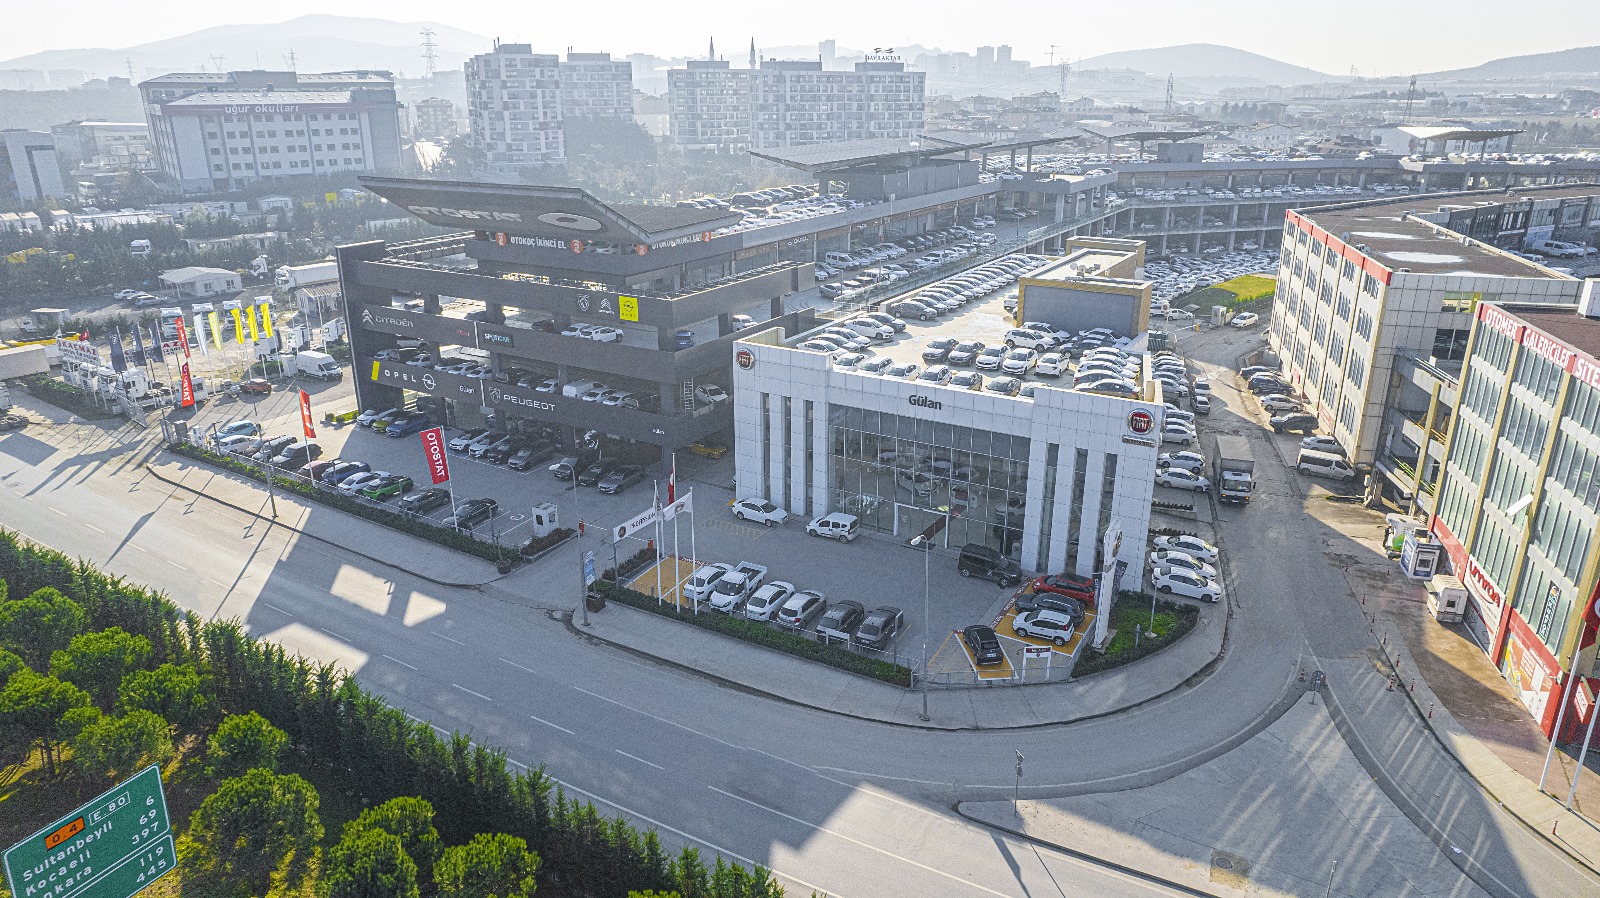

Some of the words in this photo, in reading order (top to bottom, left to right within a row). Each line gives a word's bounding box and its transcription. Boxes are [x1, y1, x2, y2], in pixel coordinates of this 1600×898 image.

[225, 104, 250, 115] uğur
[254, 103, 299, 113] okulları
[510, 236, 536, 248] OTOKOÇ
[375, 315, 414, 328] CITROËN
[1486, 308, 1519, 340] OTOMER
[384, 369, 417, 383] OPEL
[503, 394, 556, 411] PEUGEOT
[908, 394, 942, 411] Gülan
[1132, 415, 1150, 430] FIAT
[426, 432, 445, 477] OTOSTAT
[23, 820, 113, 881] Sultanbeyli
[146, 795, 155, 806] 6
[25, 849, 91, 897] Kocaeli
[139, 808, 157, 825] 69
[43, 866, 92, 898] nkara
[131, 821, 159, 845] 397
[140, 846, 164, 867] 119
[136, 859, 167, 883] 445
